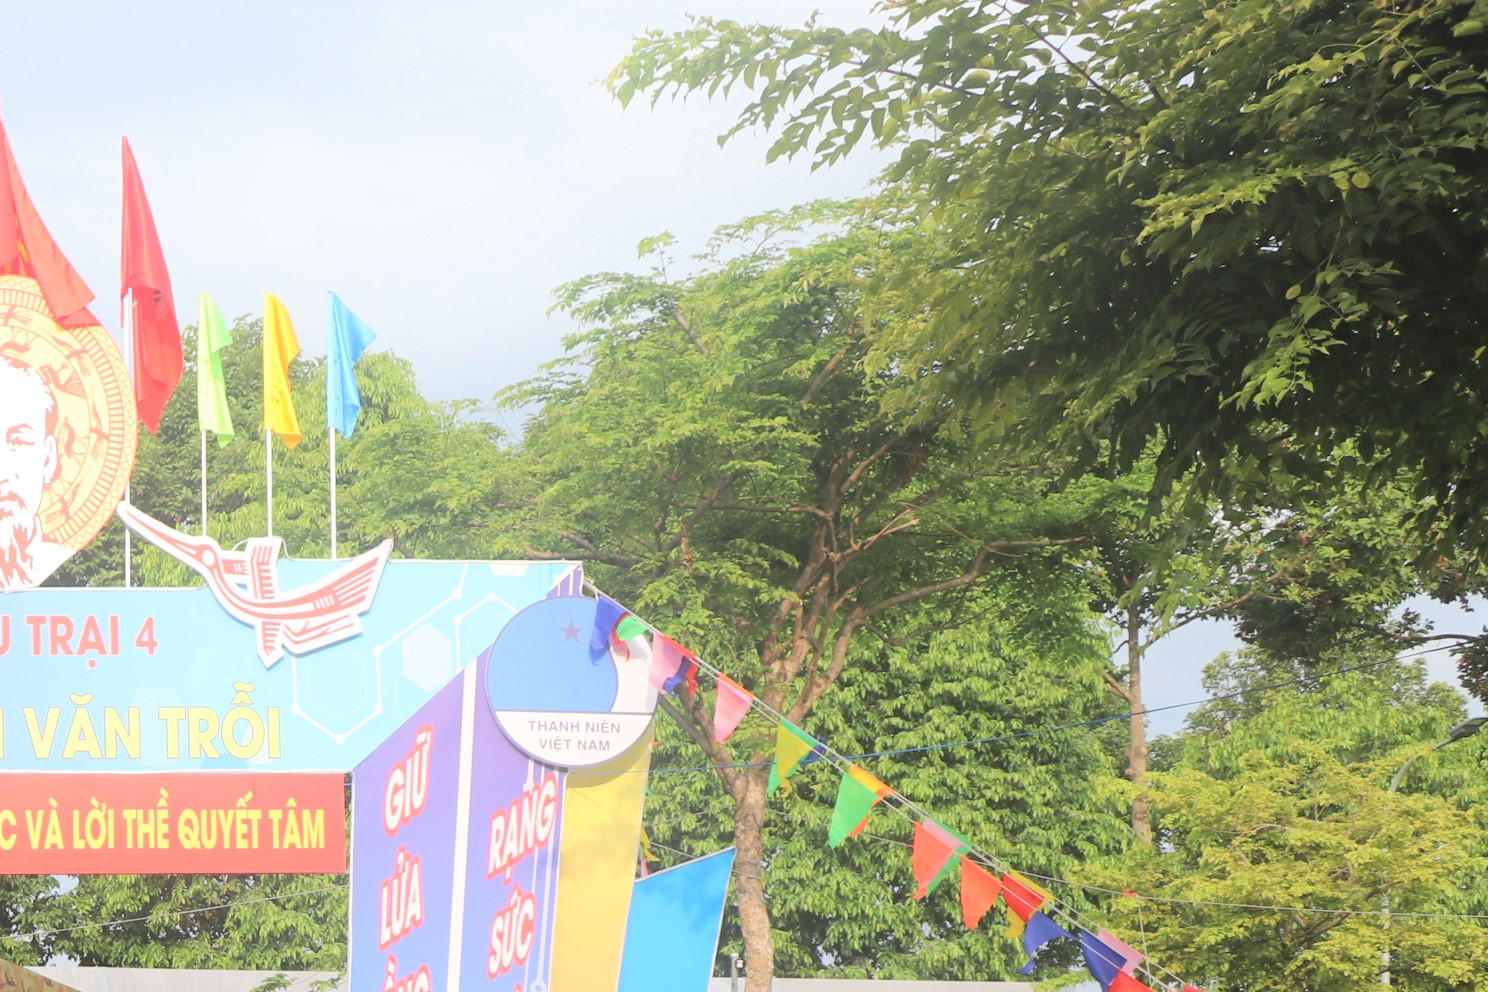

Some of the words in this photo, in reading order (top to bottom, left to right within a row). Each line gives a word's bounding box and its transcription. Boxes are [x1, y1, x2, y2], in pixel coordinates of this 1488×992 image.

[25, 614, 120, 669] TRẠI
[135, 615, 159, 656] 4
[22, 692, 141, 759] VĂN
[158, 681, 281, 759] TRỖI
[528, 720, 580, 732] THANH
[585, 719, 621, 733] NIÊN
[539, 736, 572, 752] VIỆT
[577, 740, 610, 751] NAM
[25, 797, 64, 849] VÀ
[73, 796, 115, 849] LỜI
[123, 787, 169, 849] THỀ
[178, 790, 261, 849] QUYẾT
[269, 797, 325, 849] TÂM
[384, 725, 433, 835] GIỮ
[487, 775, 557, 884] RẠNG
[380, 845, 424, 951] LỬA
[489, 883, 536, 978] SỨC
